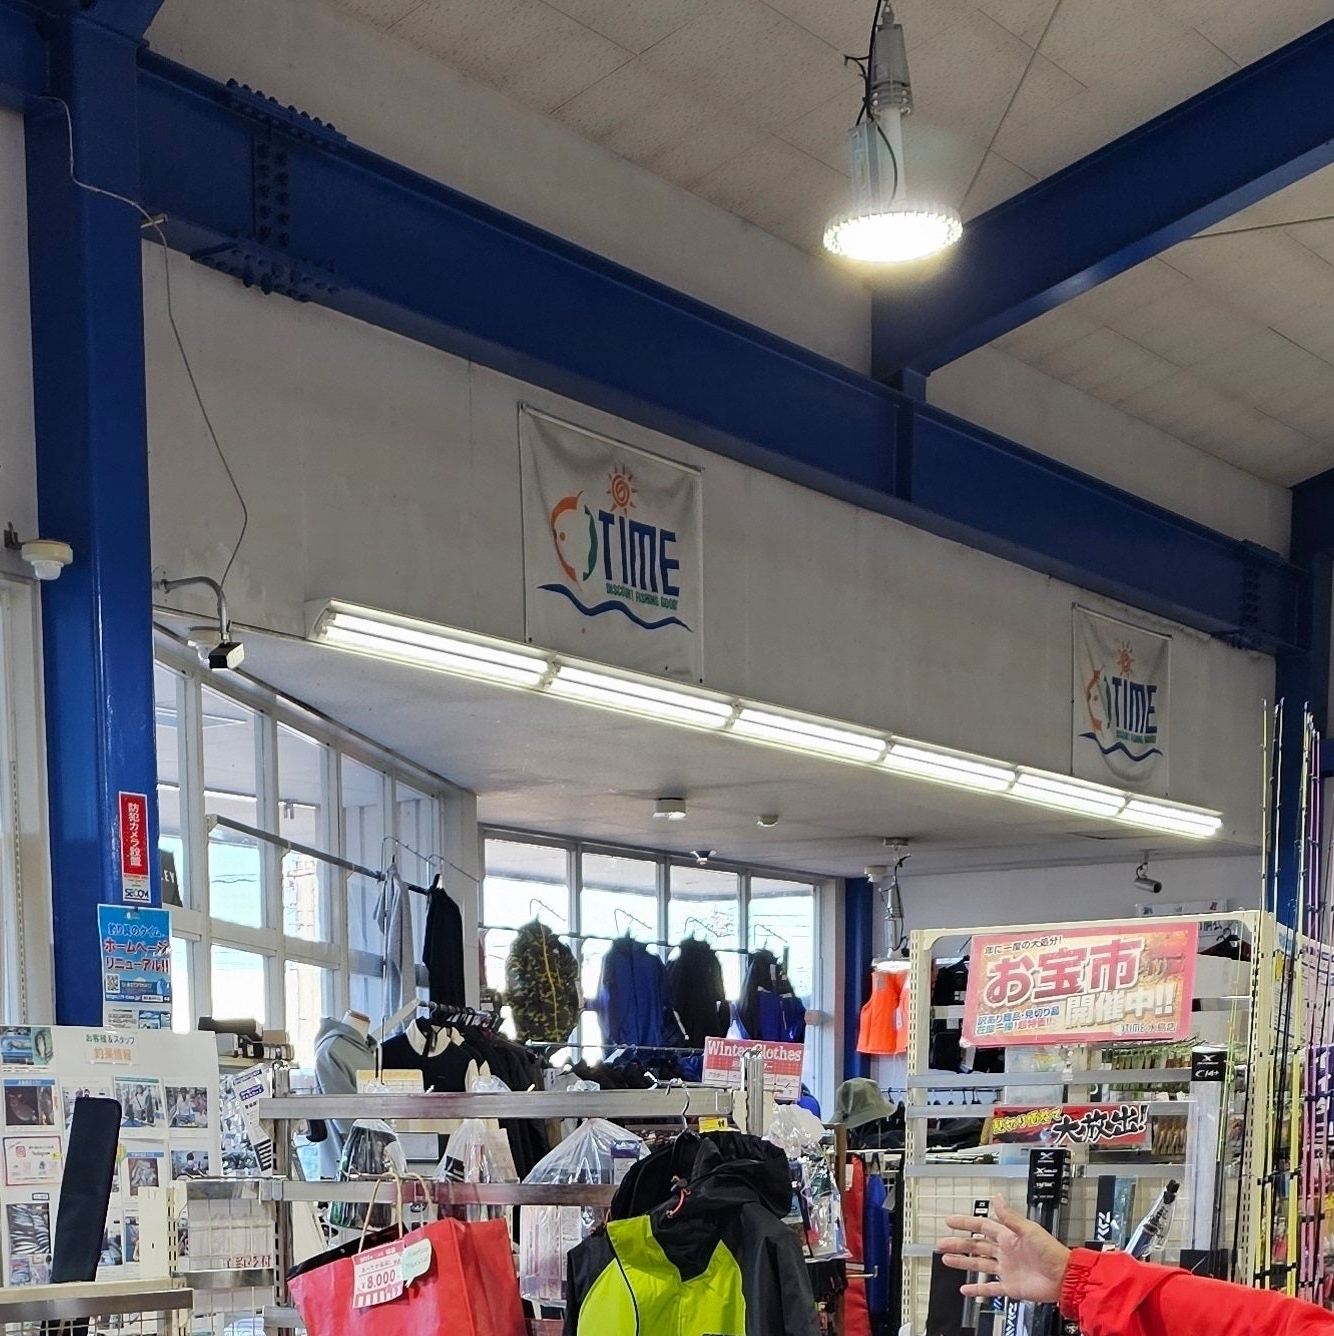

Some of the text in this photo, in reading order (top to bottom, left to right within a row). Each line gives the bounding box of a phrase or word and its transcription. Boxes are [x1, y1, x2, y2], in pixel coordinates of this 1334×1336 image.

[598, 509, 681, 597] TIME
[1112, 677, 1157, 733] TIME
[127, 802, 142, 868] 防犯カメラ設置
[124, 888, 150, 899] SECOM
[104, 939, 170, 954] ホームページ
[984, 935, 1063, 955] 年に一度の大処分!
[983, 937, 1145, 1008] お宝市
[977, 1006, 1060, 1025] 訳あり商品・見切り品
[1066, 983, 1175, 1030] 開催中!!
[754, 1043, 802, 1062] Clothes
[1052, 1104, 1149, 1143] 大放出!
